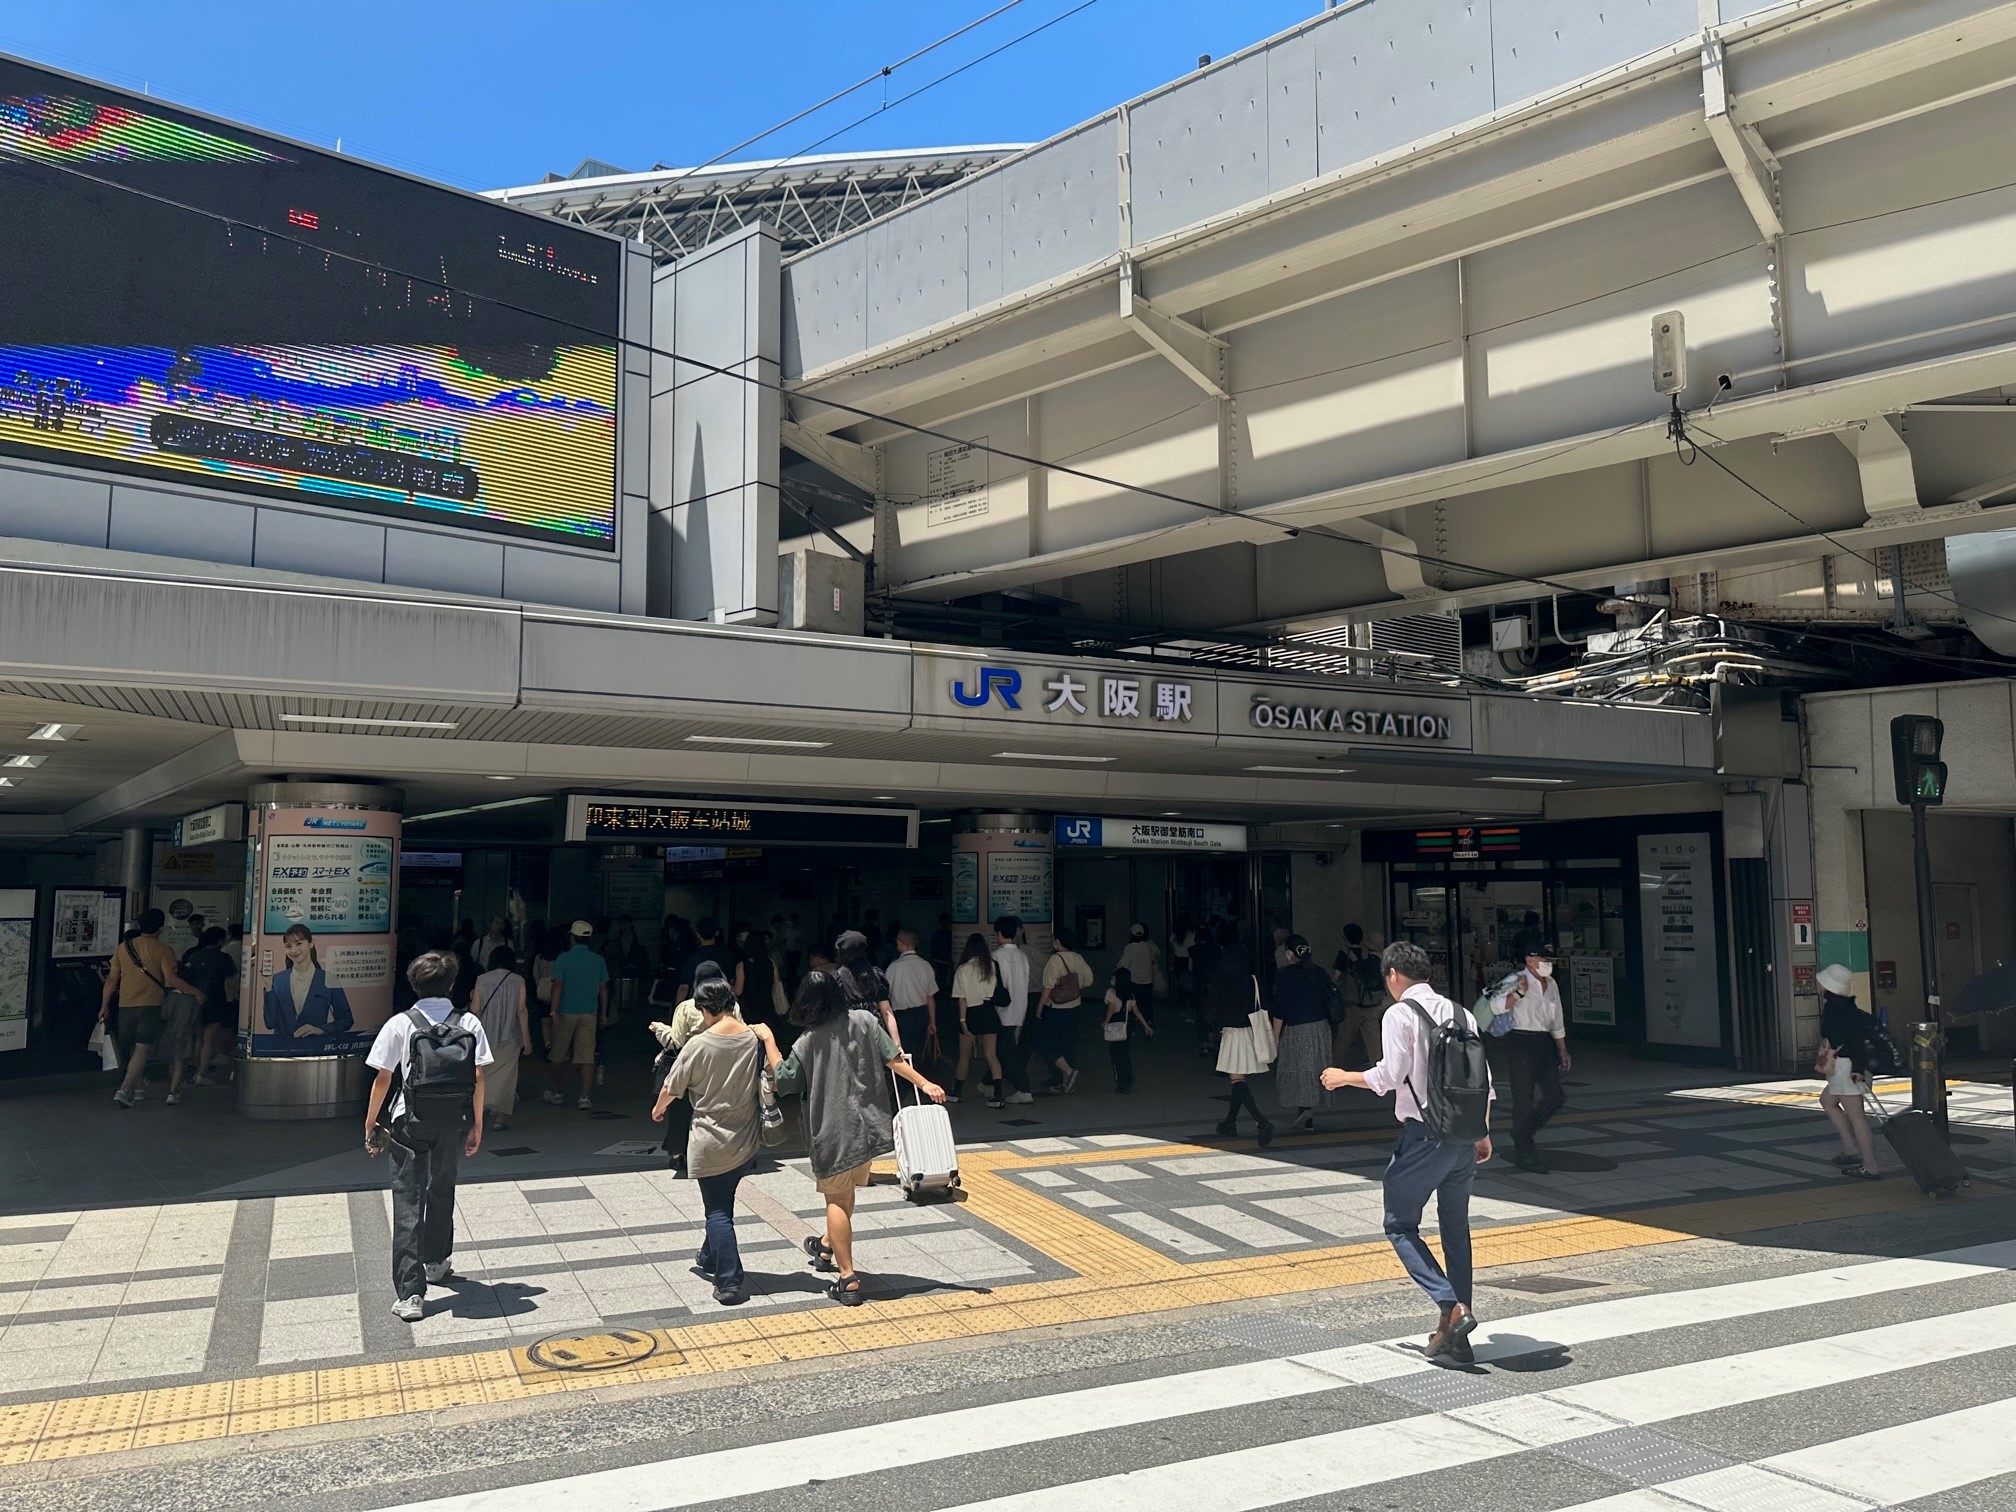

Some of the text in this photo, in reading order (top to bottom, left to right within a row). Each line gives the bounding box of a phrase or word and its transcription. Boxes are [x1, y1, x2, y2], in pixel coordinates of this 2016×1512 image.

[950, 667, 1193, 721] JR 大阪駅
[1254, 697, 1452, 739] ŌSAKA STATION
[307, 817, 318, 825] JR
[1066, 820, 1091, 838] JR
[1132, 825, 1204, 839] 大阪駅御堂筋南口
[273, 867, 351, 878] EX予約 スマートEX
